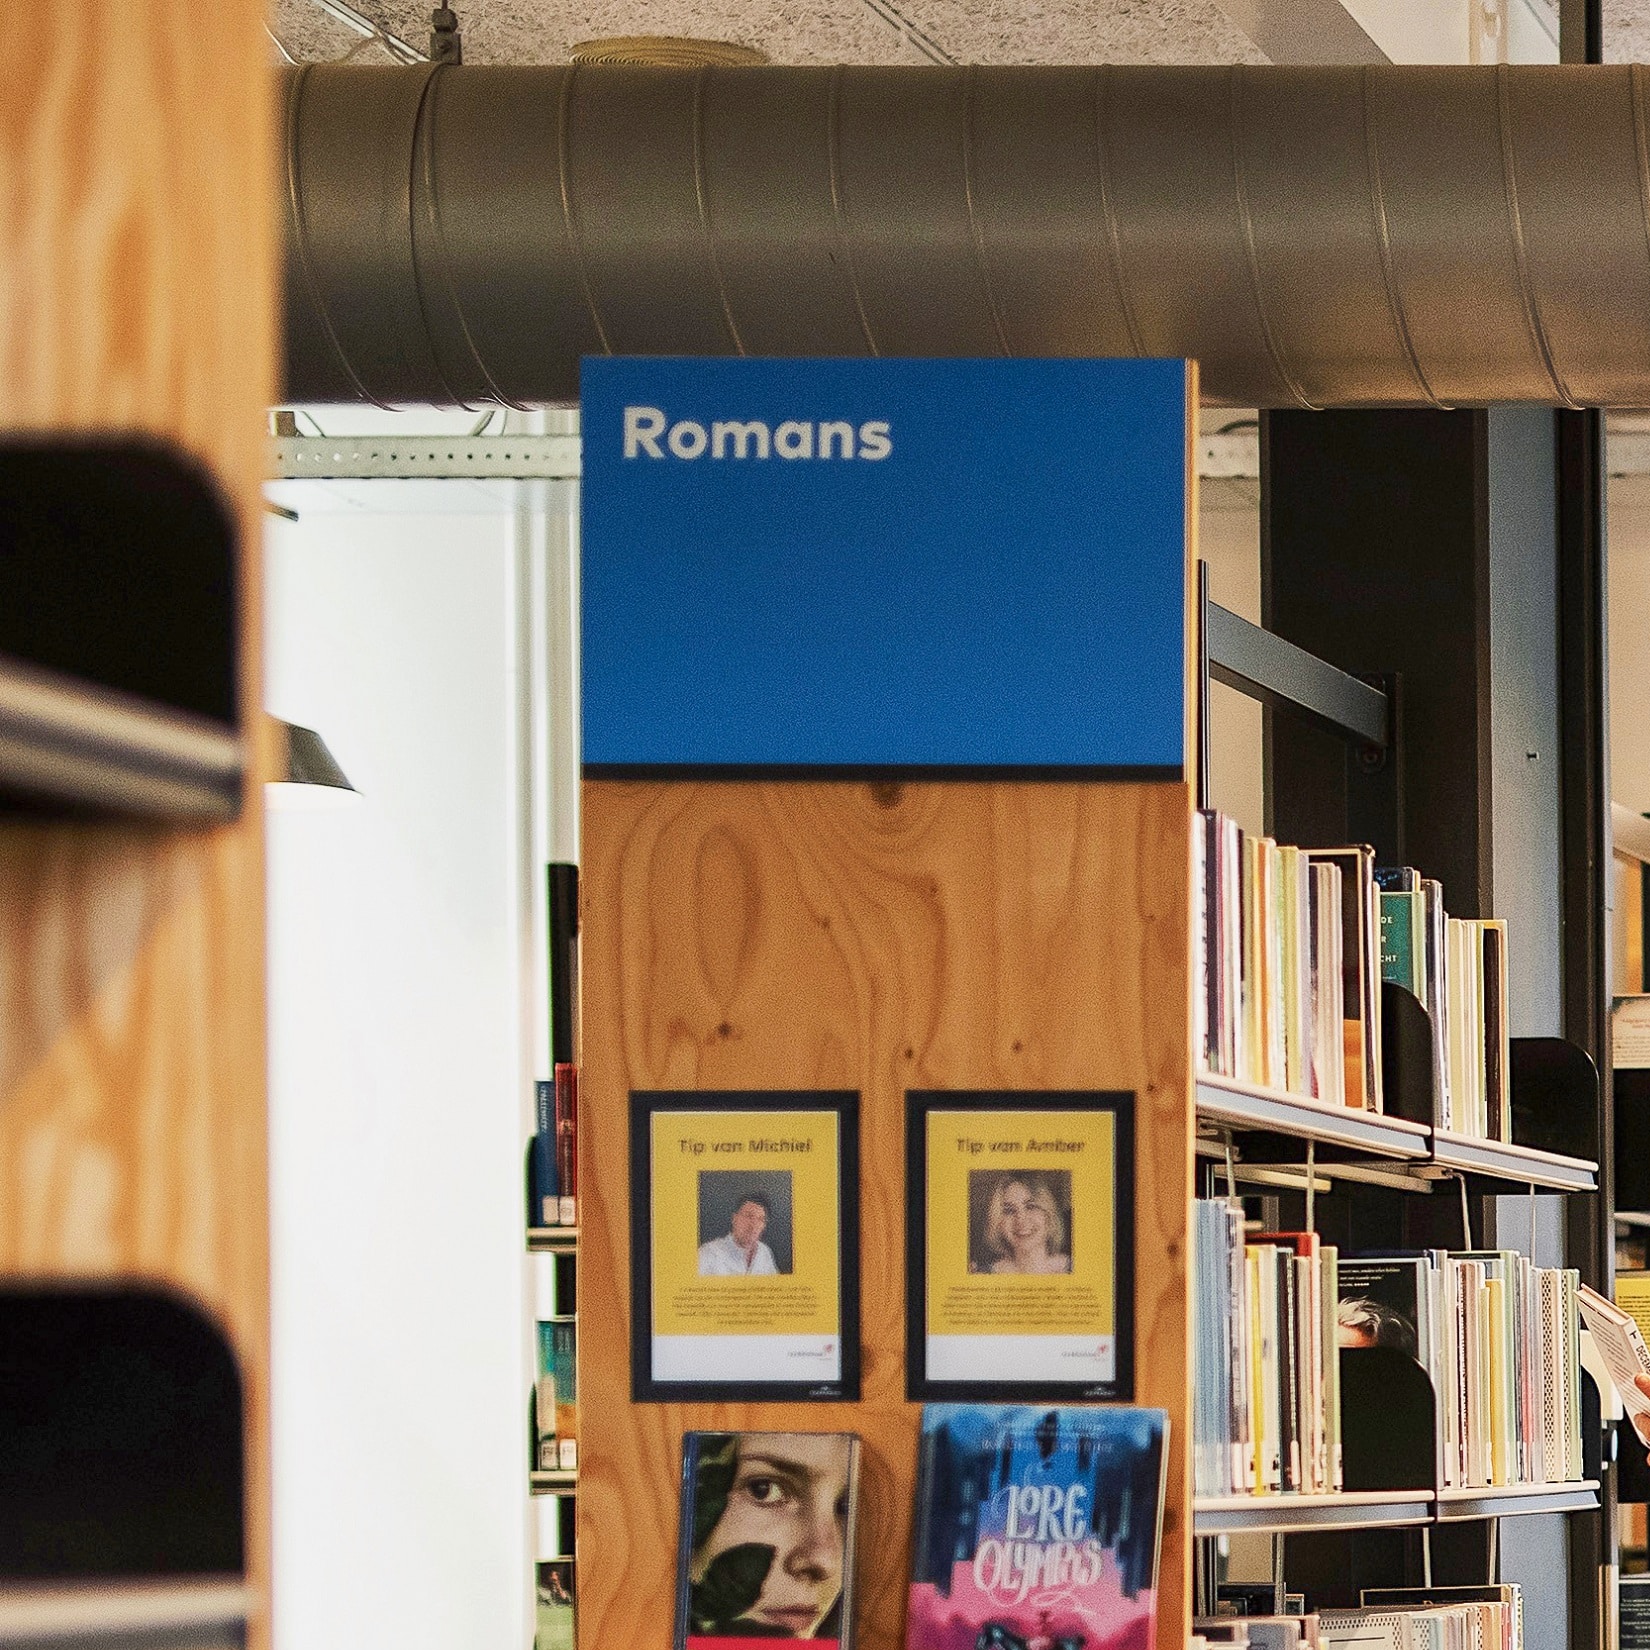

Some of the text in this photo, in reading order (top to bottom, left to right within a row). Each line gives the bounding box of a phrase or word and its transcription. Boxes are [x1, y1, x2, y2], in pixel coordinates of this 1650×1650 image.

[623, 405, 893, 461] Romans
[679, 1137, 813, 1156] Tip van Michiel
[957, 1138, 984, 1155] Tip
[989, 1140, 1022, 1153] van
[1002, 1483, 1088, 1542] LORE
